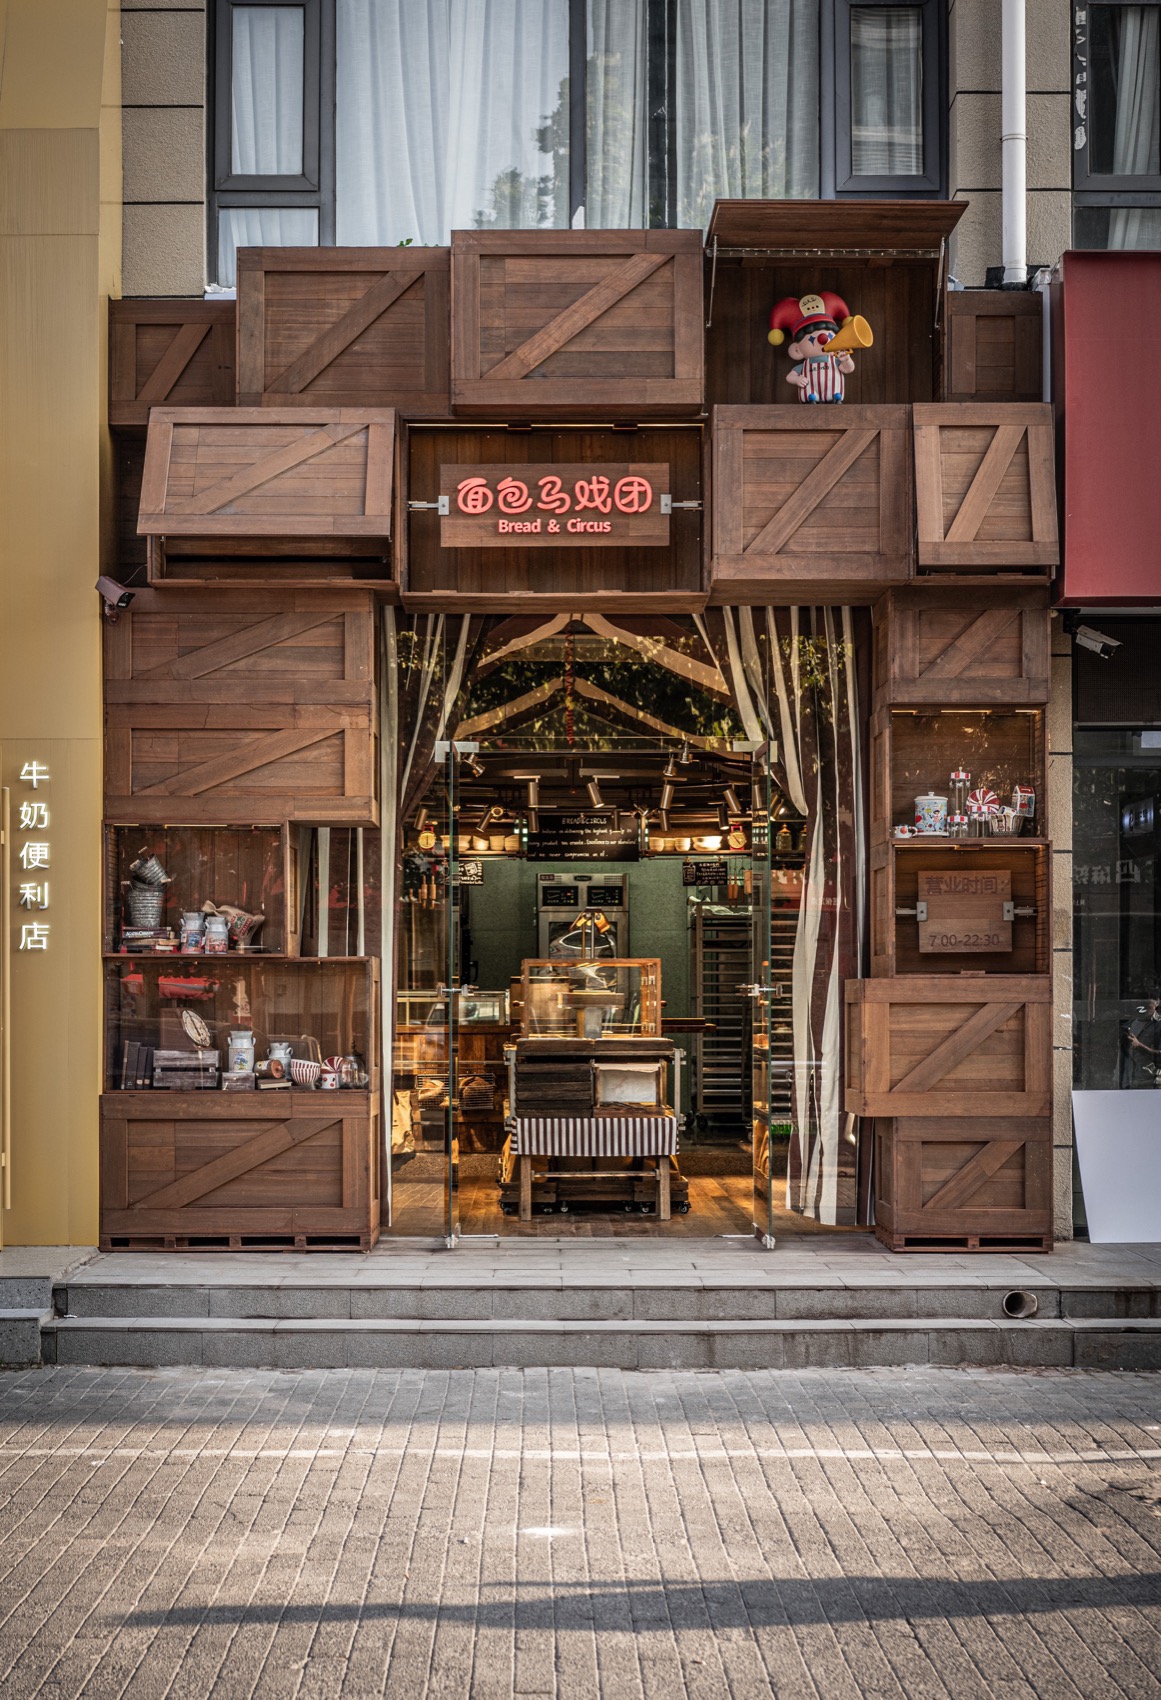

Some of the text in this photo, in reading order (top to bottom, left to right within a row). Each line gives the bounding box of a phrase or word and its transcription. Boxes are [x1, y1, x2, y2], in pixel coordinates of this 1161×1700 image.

[457, 475, 653, 514] 面包马戏团
[498, 518, 612, 533] Bread & Circus
[19, 760, 50, 951] 牛奶便利店
